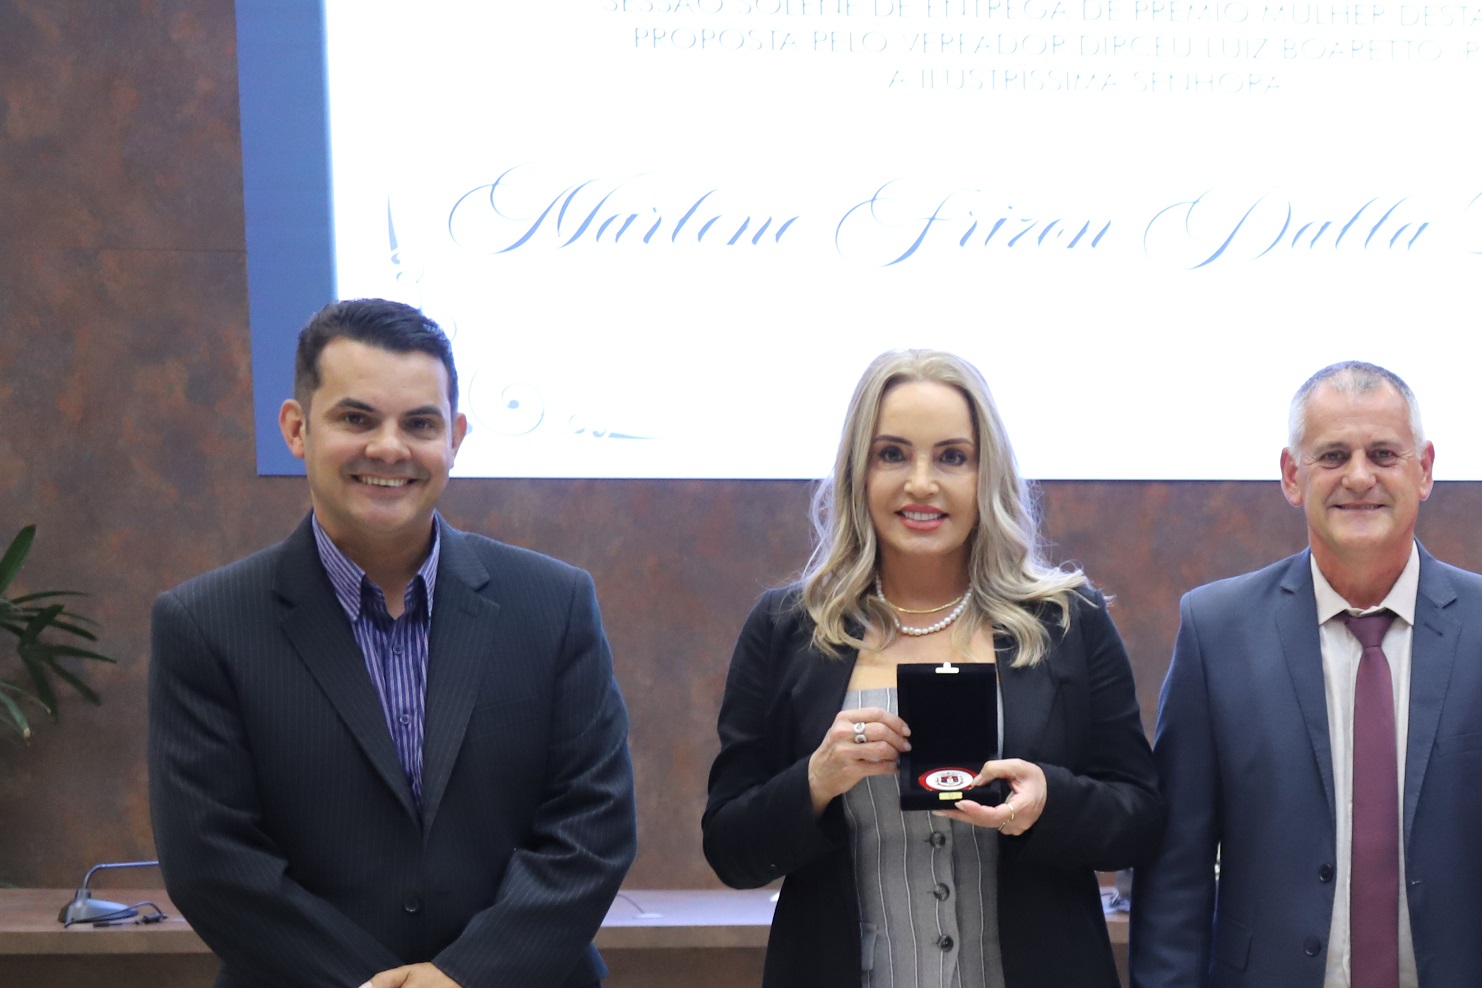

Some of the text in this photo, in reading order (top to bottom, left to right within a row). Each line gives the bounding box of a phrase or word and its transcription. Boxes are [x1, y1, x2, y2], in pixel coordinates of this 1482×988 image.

[873, 0, 912, 18] DE
[927, 0, 1067, 20] ENTREGA
[1082, 0, 1121, 21] DE
[1262, 2, 1387, 25] MULHER
[633, 26, 799, 51] PROPOSTA
[813, 29, 888, 53] PELO
[901, 32, 1066, 56] VEREADOR
[1079, 34, 1192, 58] DIRCEU
[1207, 36, 1269, 60] LUIZ
[1282, 37, 1443, 62] BOARETTO
[1132, 68, 1281, 96] SENHORA
